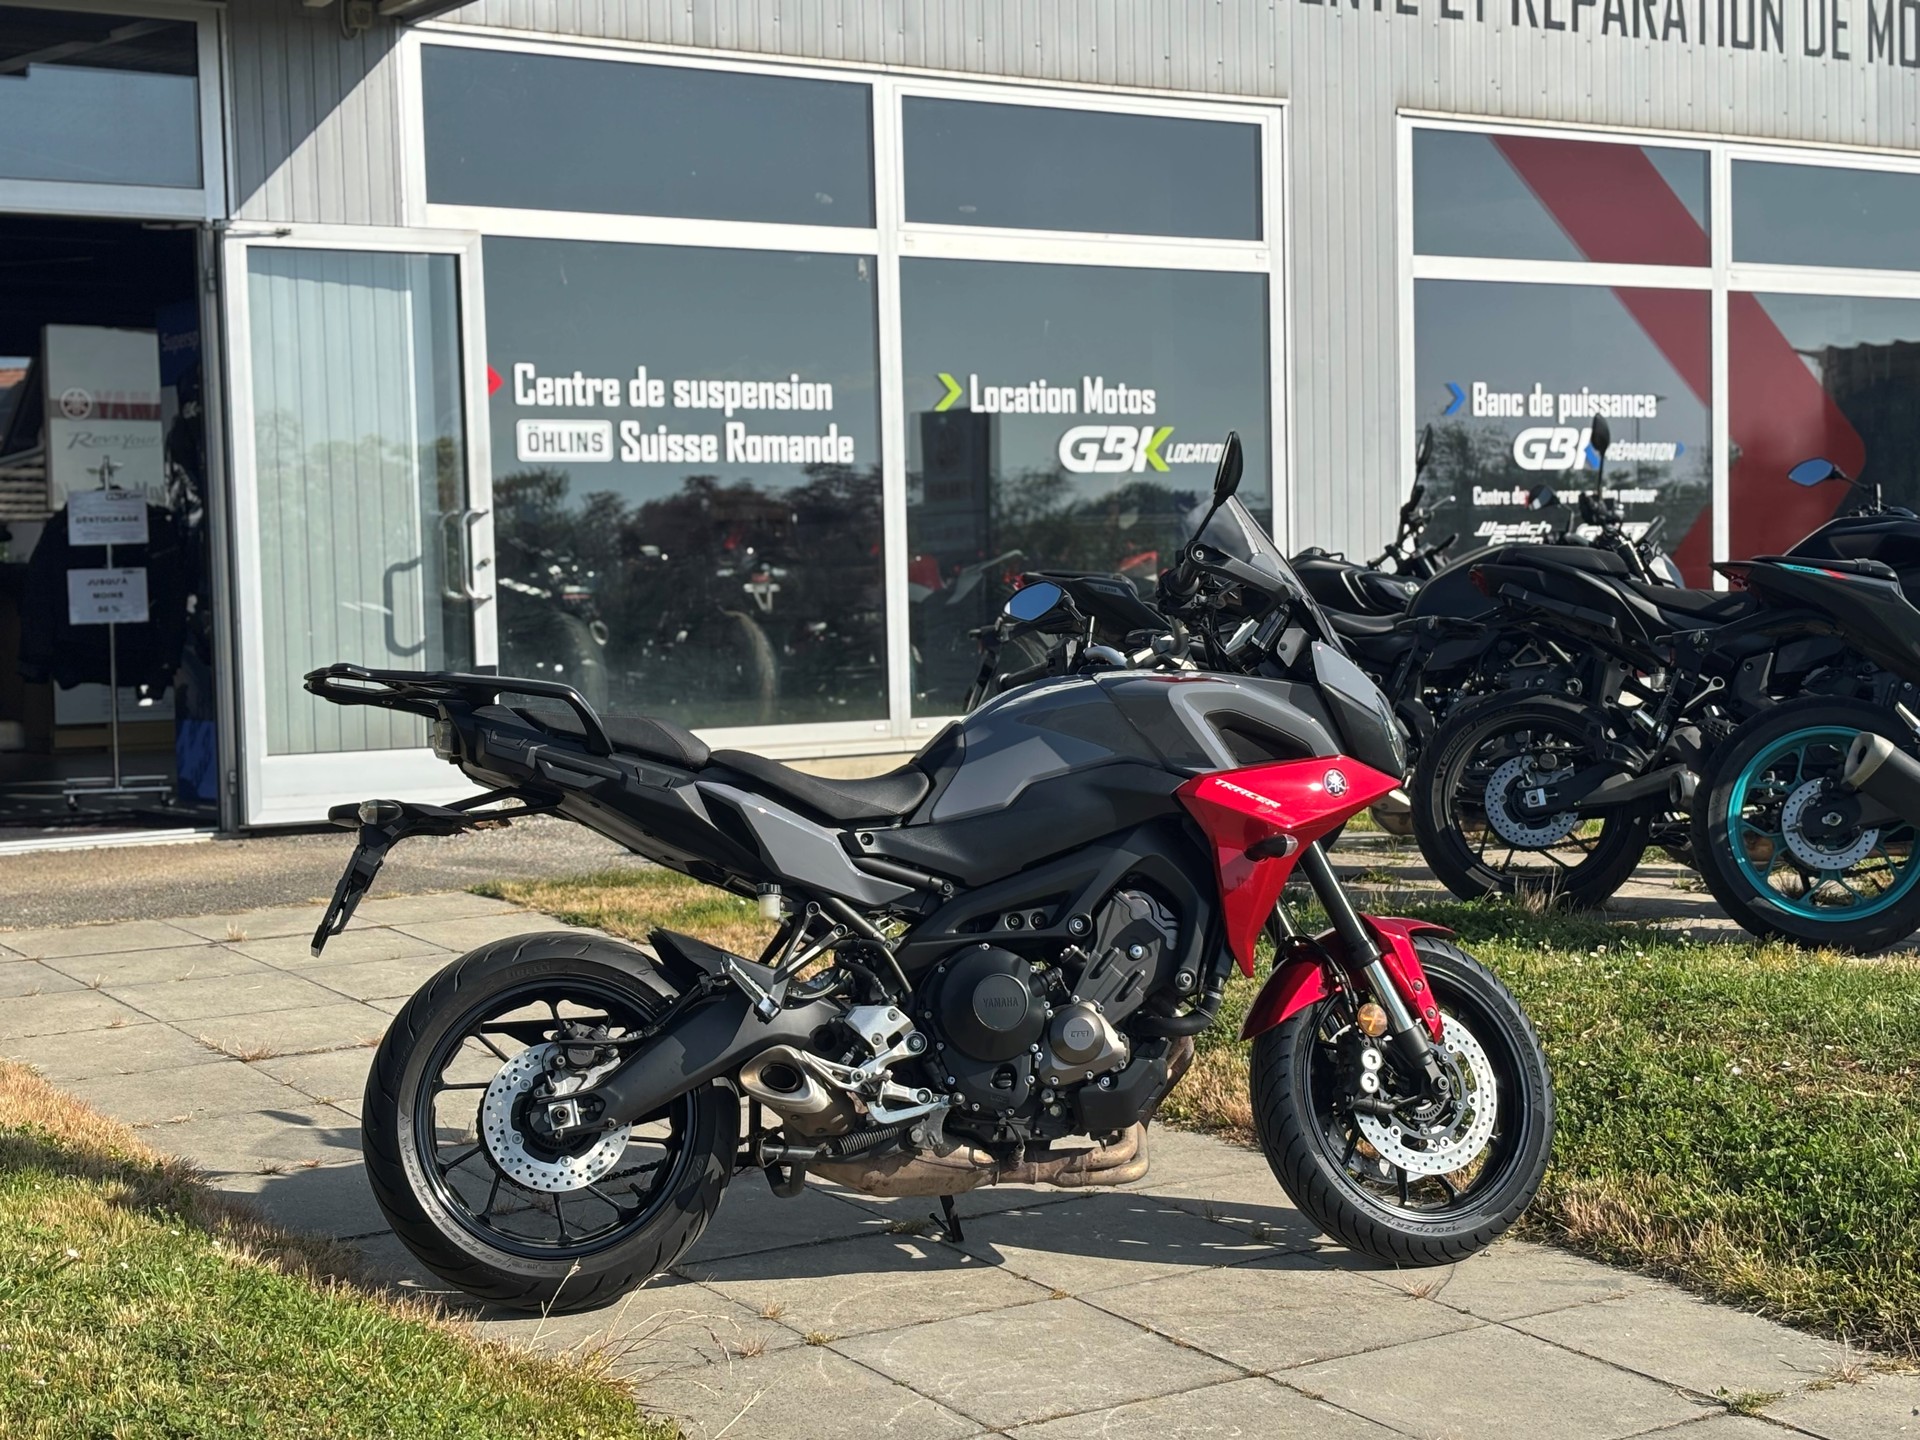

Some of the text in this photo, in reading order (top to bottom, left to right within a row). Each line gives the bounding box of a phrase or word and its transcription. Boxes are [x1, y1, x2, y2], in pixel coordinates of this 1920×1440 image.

[513, 362, 833, 418] Centre de suspension
[969, 374, 1156, 415] Location Motos
[1472, 381, 1656, 424] Banc de puissance
[527, 420, 854, 463] ÖHLINS Suisse Romande
[1058, 425, 1175, 473] GBK
[1472, 485, 1511, 506] Centre
[1213, 778, 1282, 809] TRACER
[982, 997, 1019, 1009] YAMAHA
